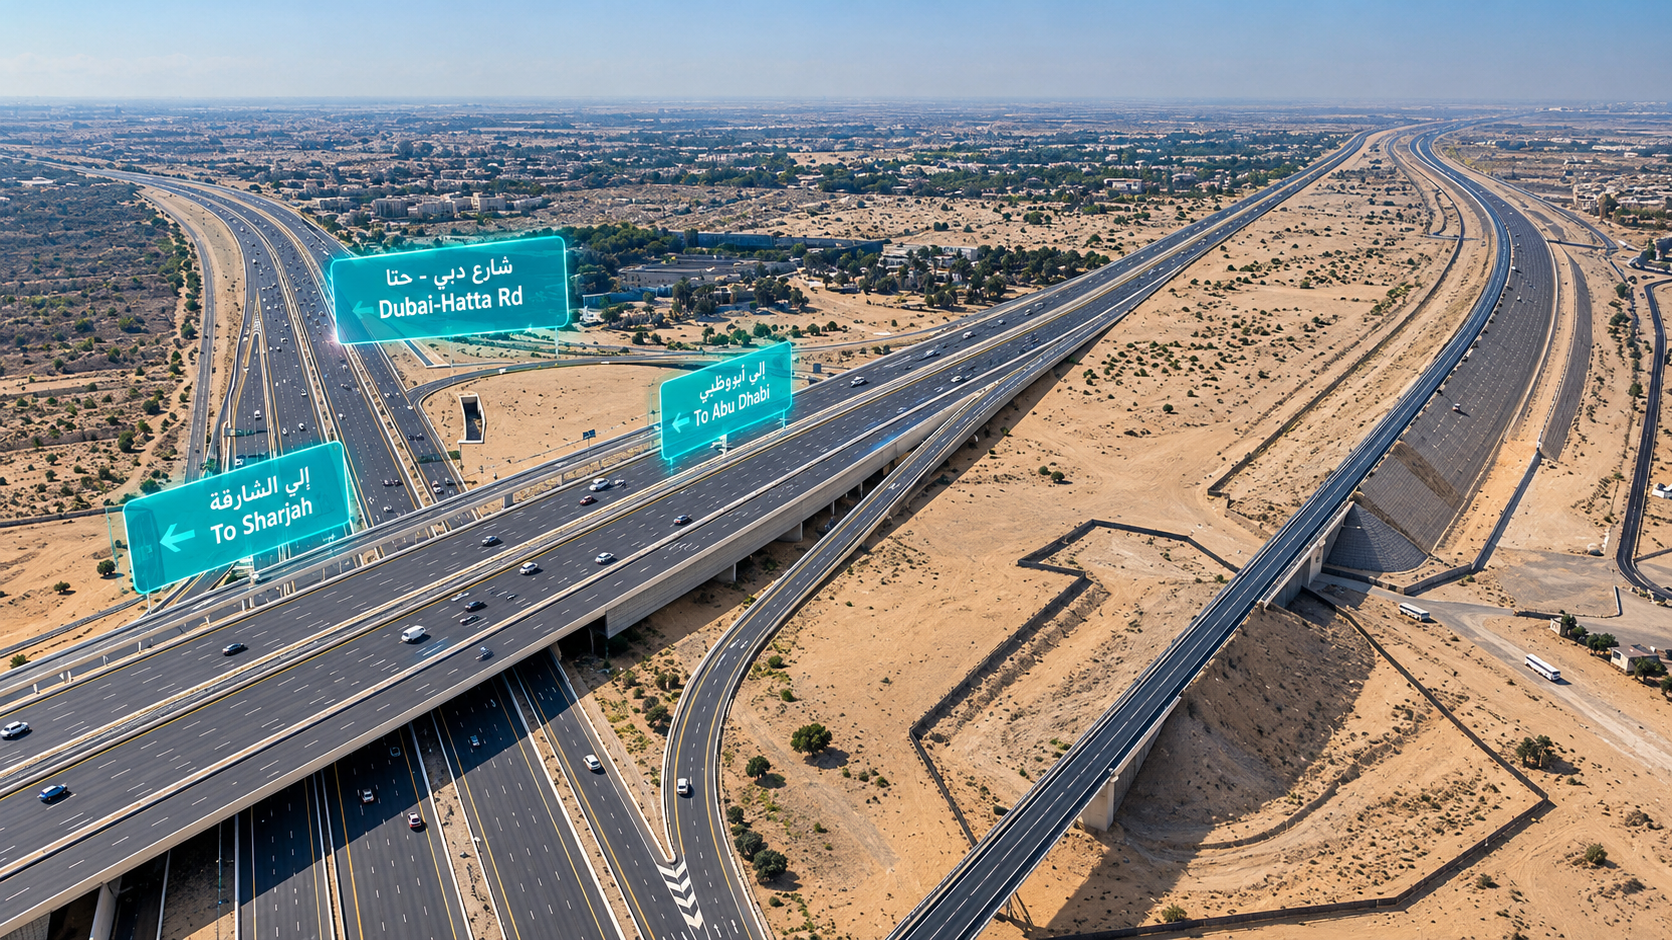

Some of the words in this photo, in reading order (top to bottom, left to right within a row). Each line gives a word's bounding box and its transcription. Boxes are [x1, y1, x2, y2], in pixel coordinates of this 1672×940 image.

[386, 269, 413, 287] حتا
[433, 266, 466, 291] دبي
[472, 256, 513, 284] شارع
[379, 293, 492, 319] Dubai-Hatta
[499, 285, 523, 307] Rd
[694, 409, 708, 427] To
[712, 401, 735, 421] Abu
[739, 384, 770, 410] Dhabi
[210, 475, 279, 511] الشارقة
[211, 522, 236, 544] To
[242, 497, 313, 535] Sharjah
